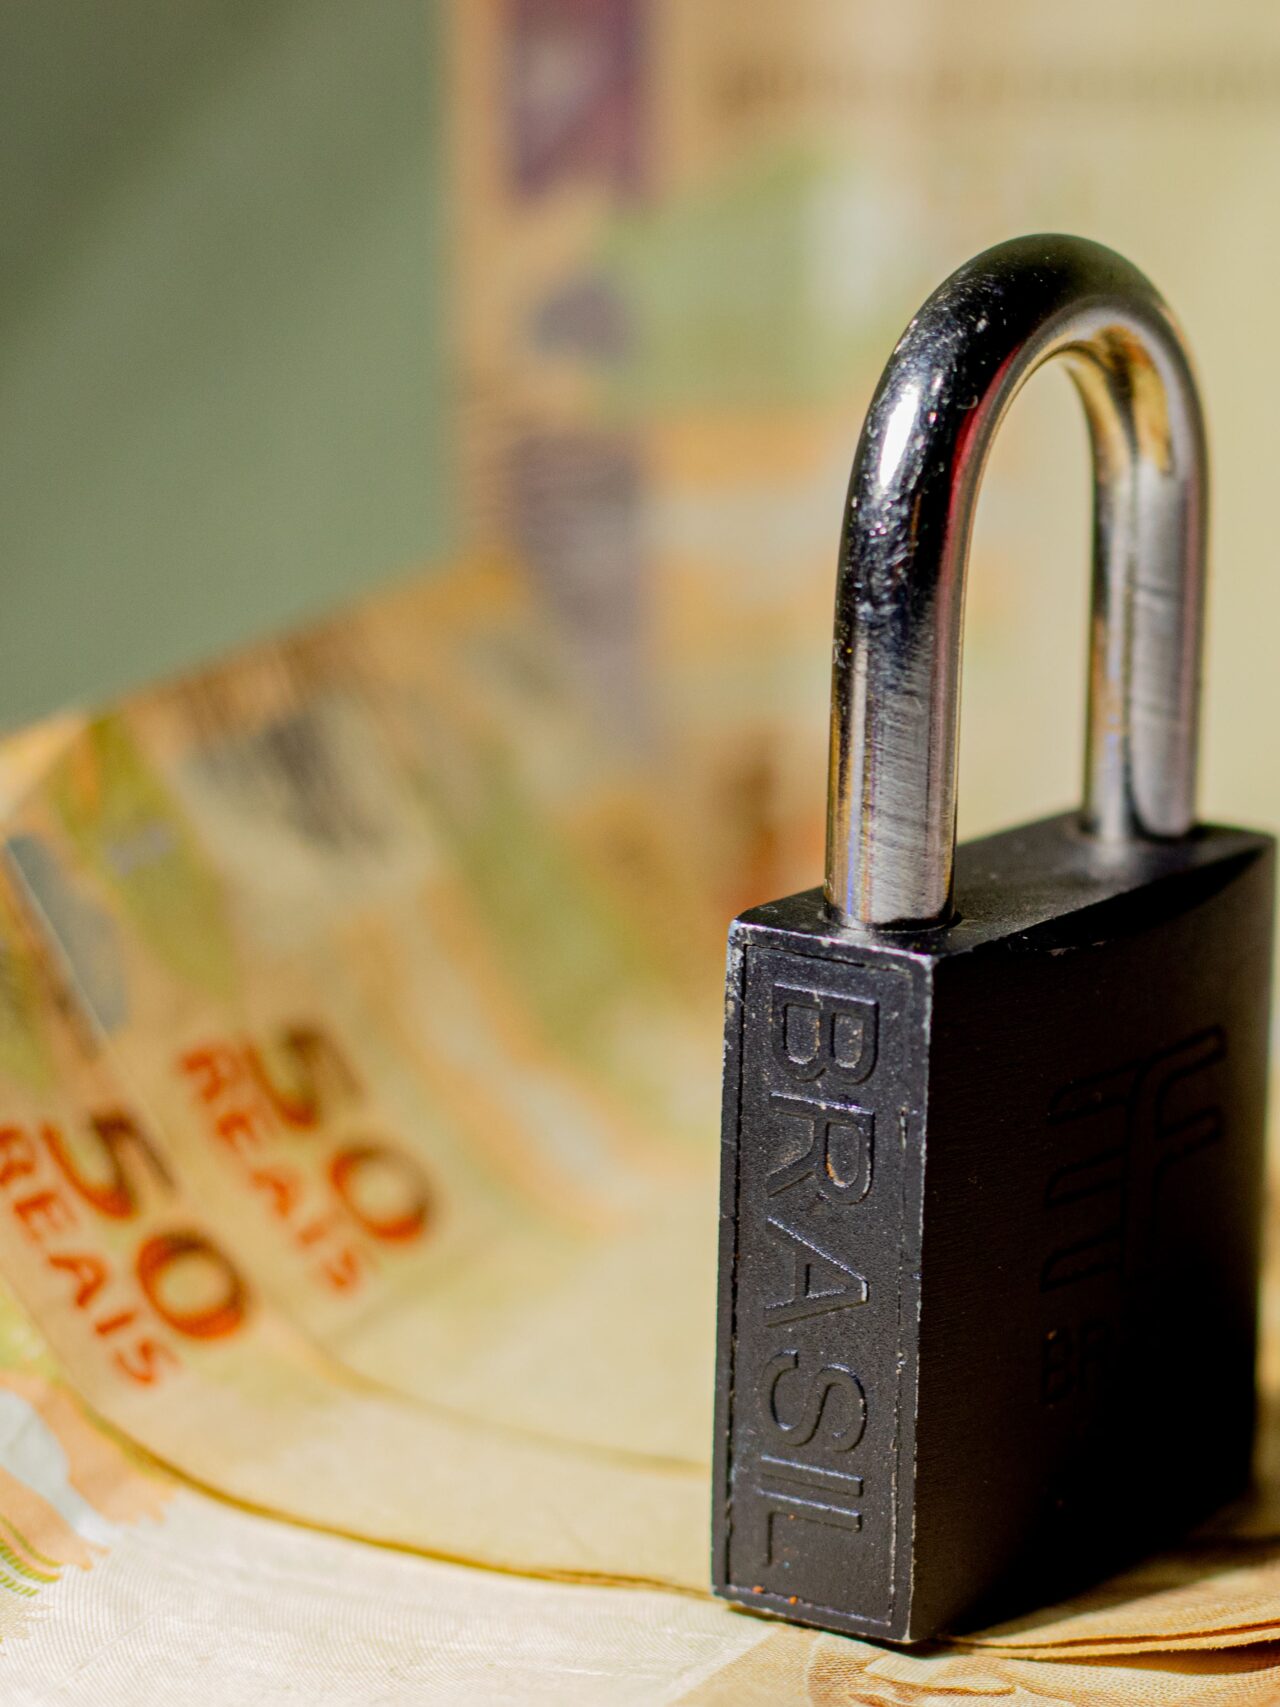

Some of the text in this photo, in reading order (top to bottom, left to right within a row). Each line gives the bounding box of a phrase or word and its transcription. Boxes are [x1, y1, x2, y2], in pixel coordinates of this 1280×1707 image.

[0, 1126, 180, 1386] REAIS
[42, 1110, 252, 1343] 50
[177, 1040, 374, 1296] REAIS
[242, 1022, 434, 1247] 50
[759, 983, 879, 1568] BRASIL
